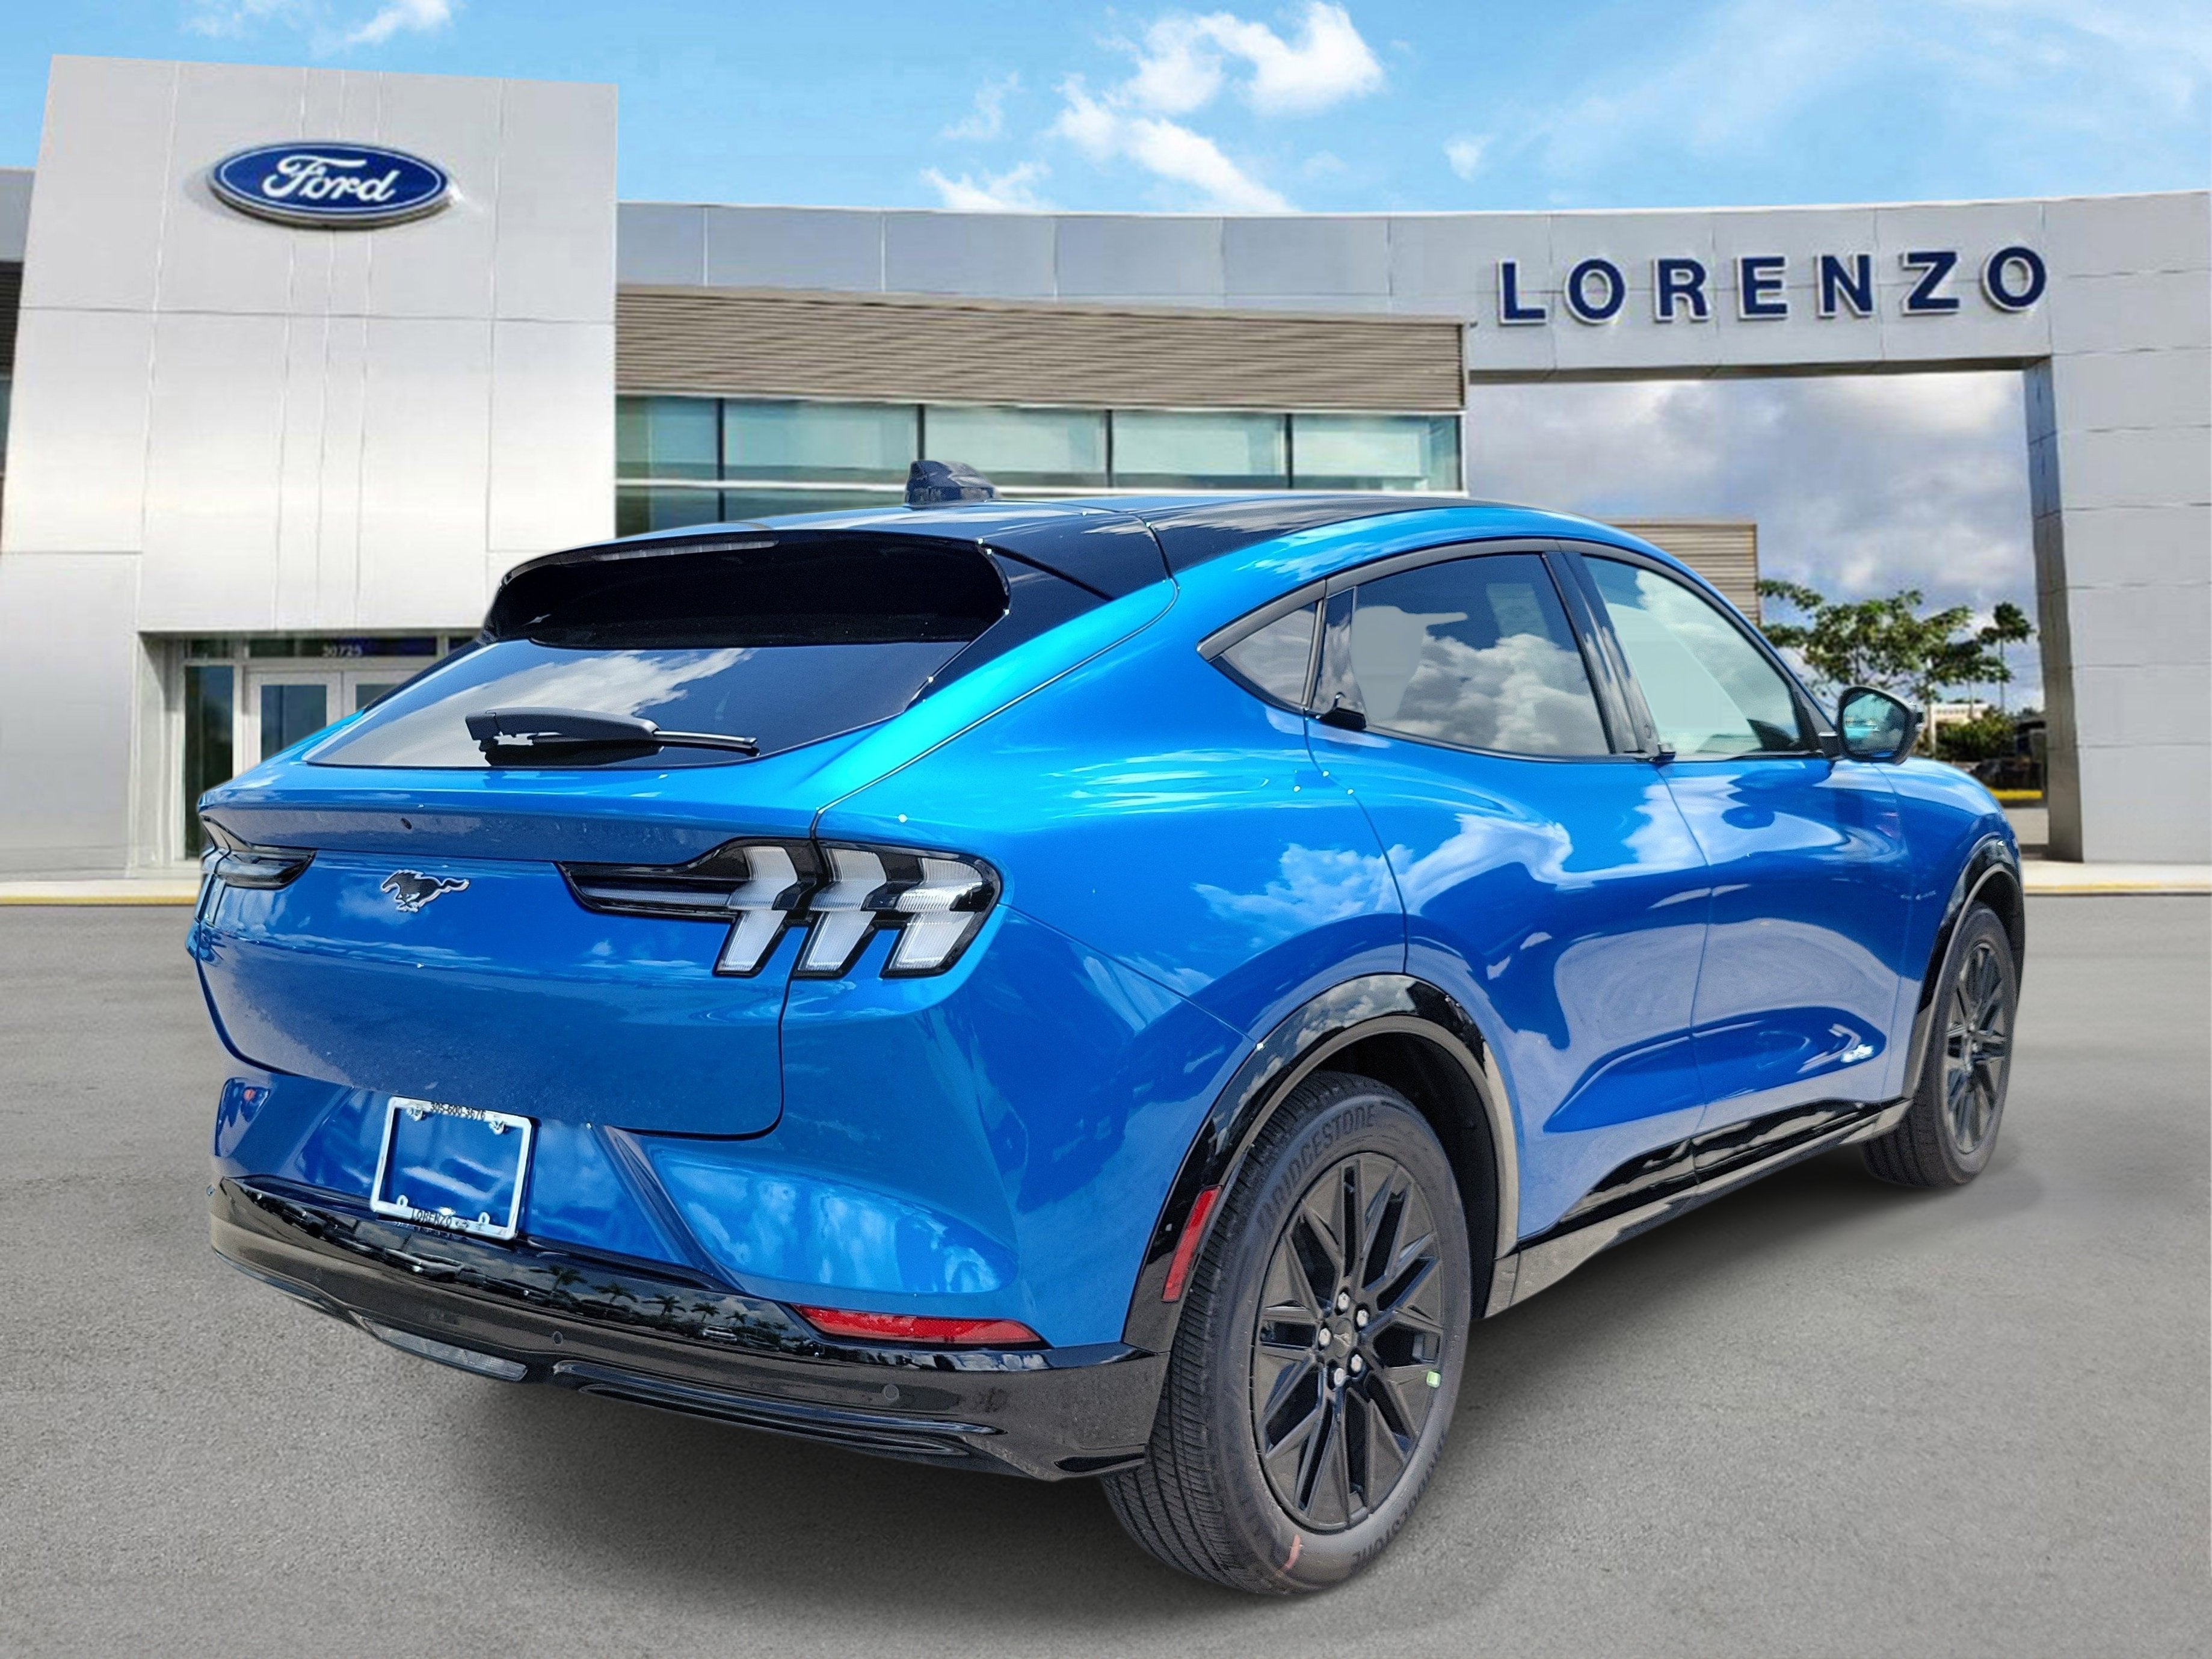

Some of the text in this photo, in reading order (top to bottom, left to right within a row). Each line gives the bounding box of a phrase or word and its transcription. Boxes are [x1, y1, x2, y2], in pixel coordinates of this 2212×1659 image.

[262, 155, 401, 202] Ford
[1497, 246, 2047, 324] LORENZO
[411, 1208, 452, 1228] LORENZO
